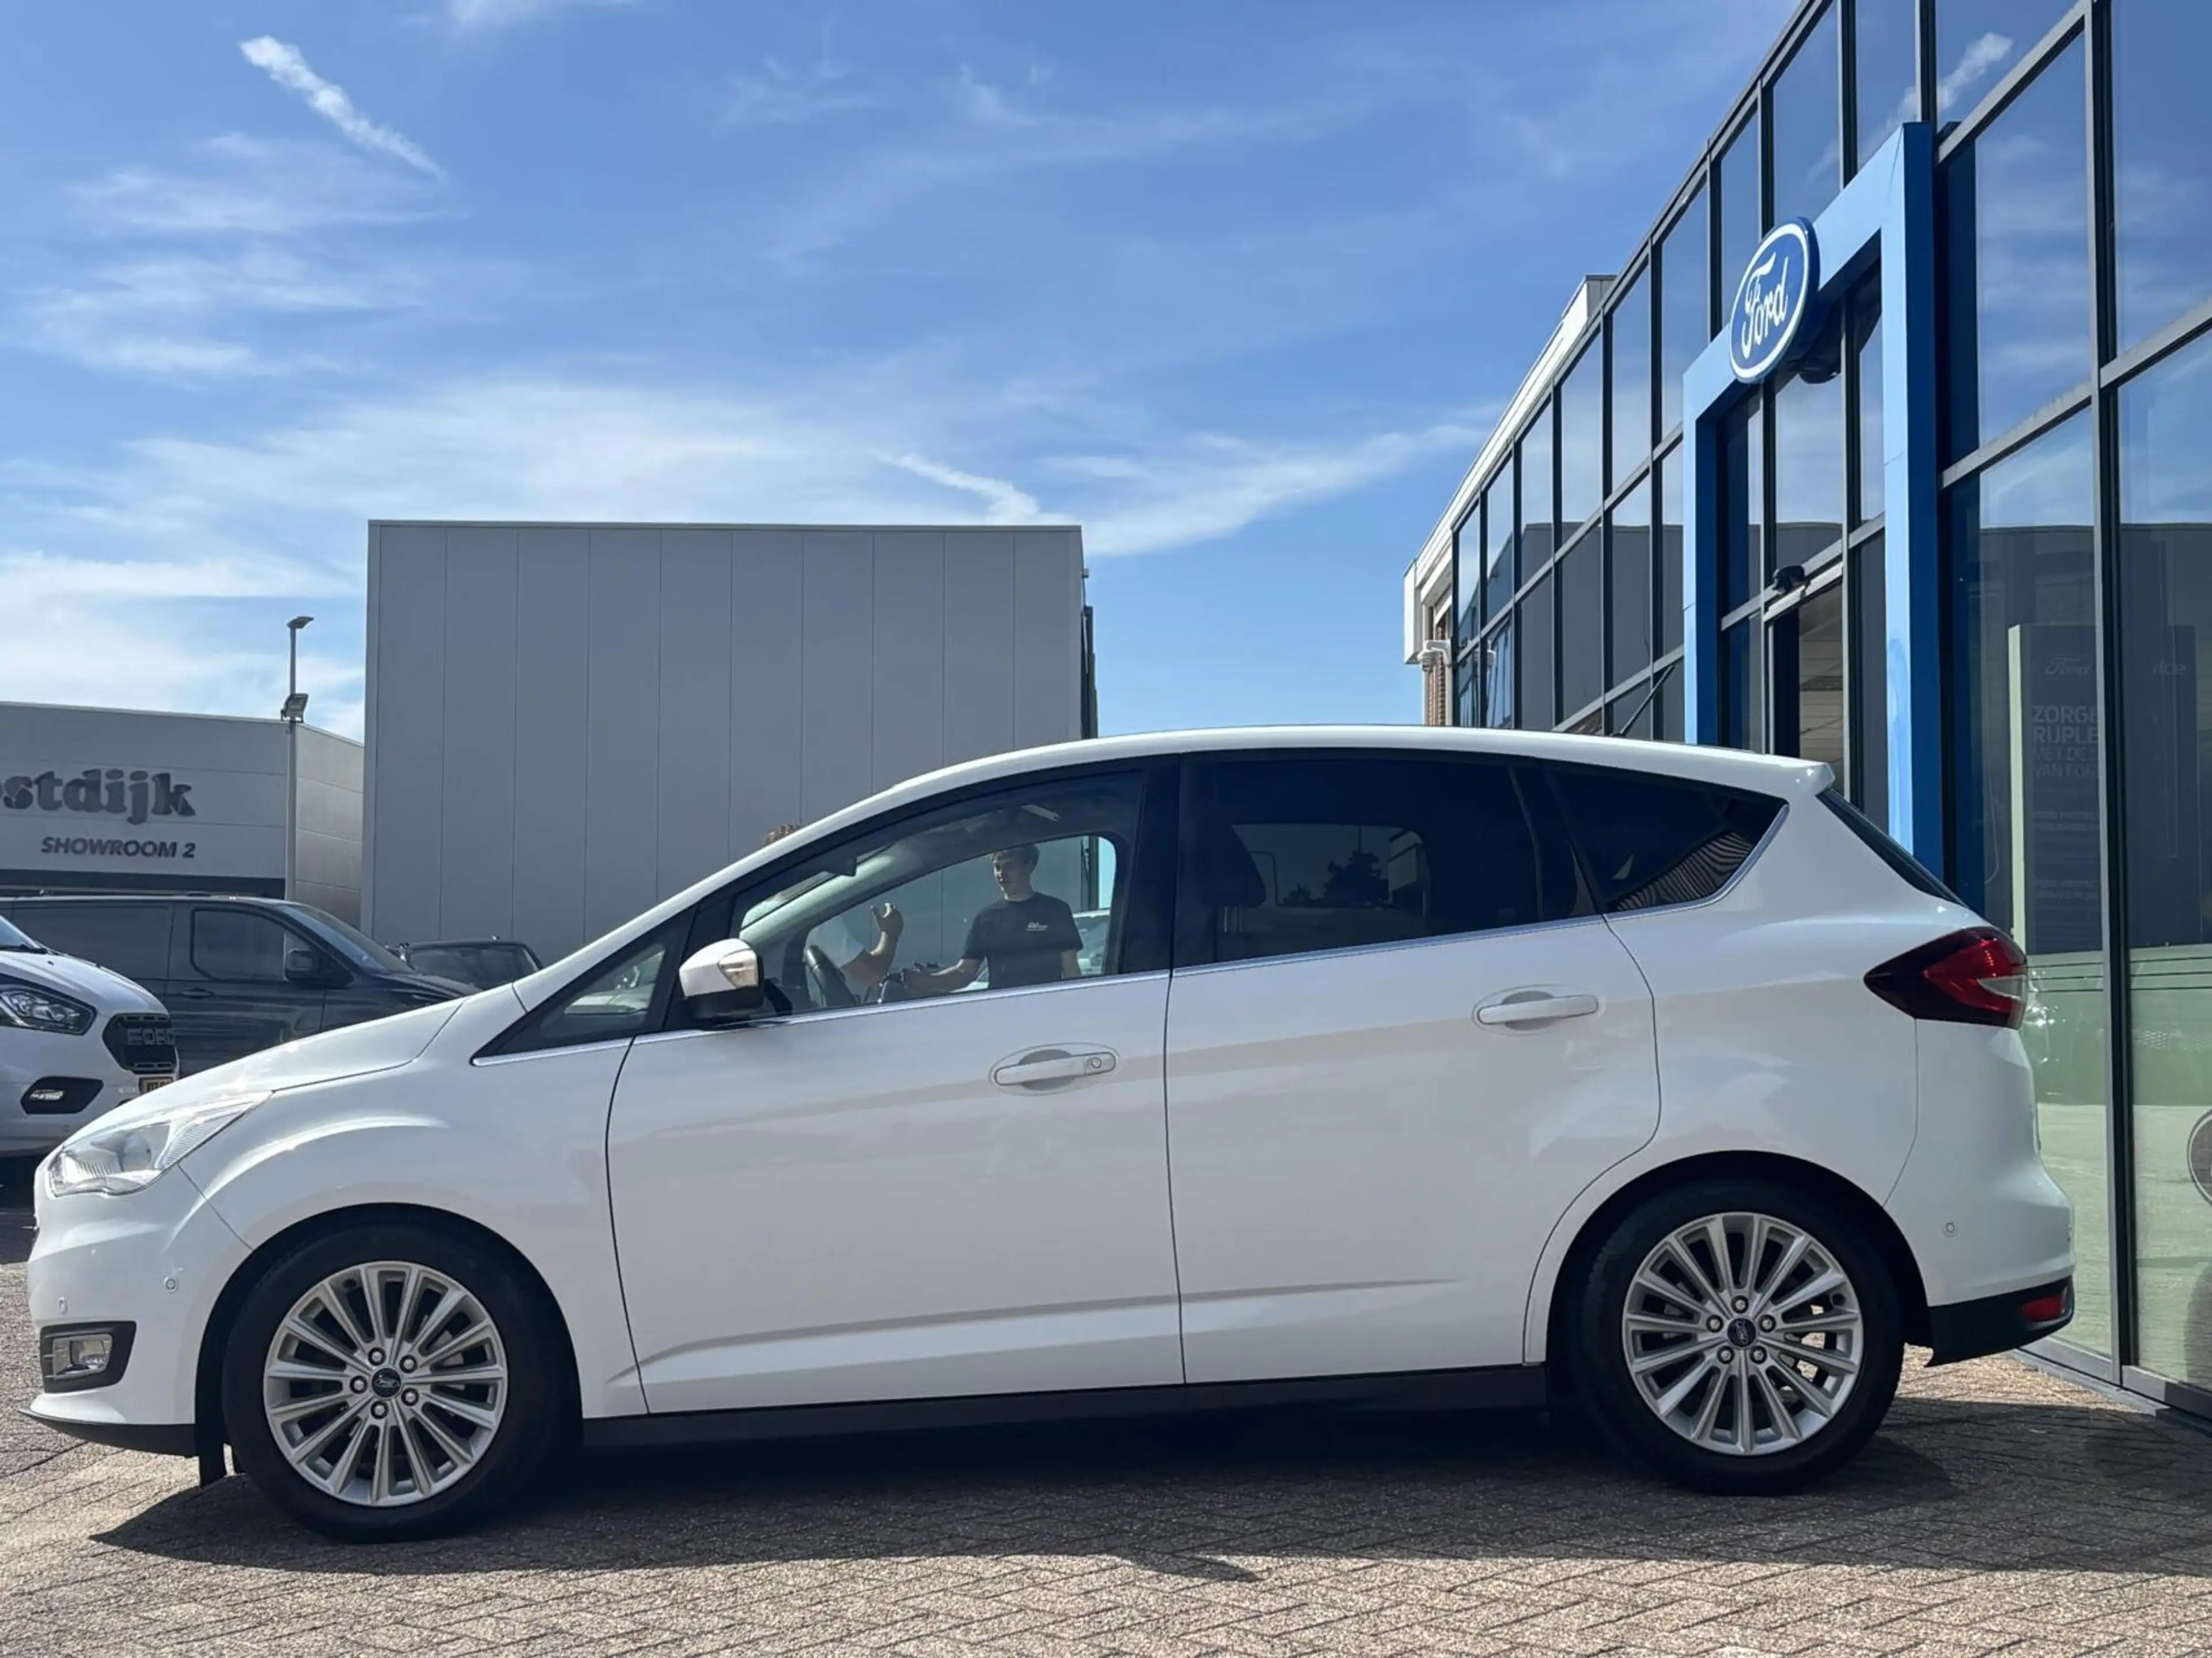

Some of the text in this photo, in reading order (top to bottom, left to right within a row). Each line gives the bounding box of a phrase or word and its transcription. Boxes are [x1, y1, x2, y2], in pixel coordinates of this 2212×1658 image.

[1741, 251, 1789, 359] Ford
[0, 768, 196, 825] stdijk
[40, 836, 196, 859] SHOWROOM 2
